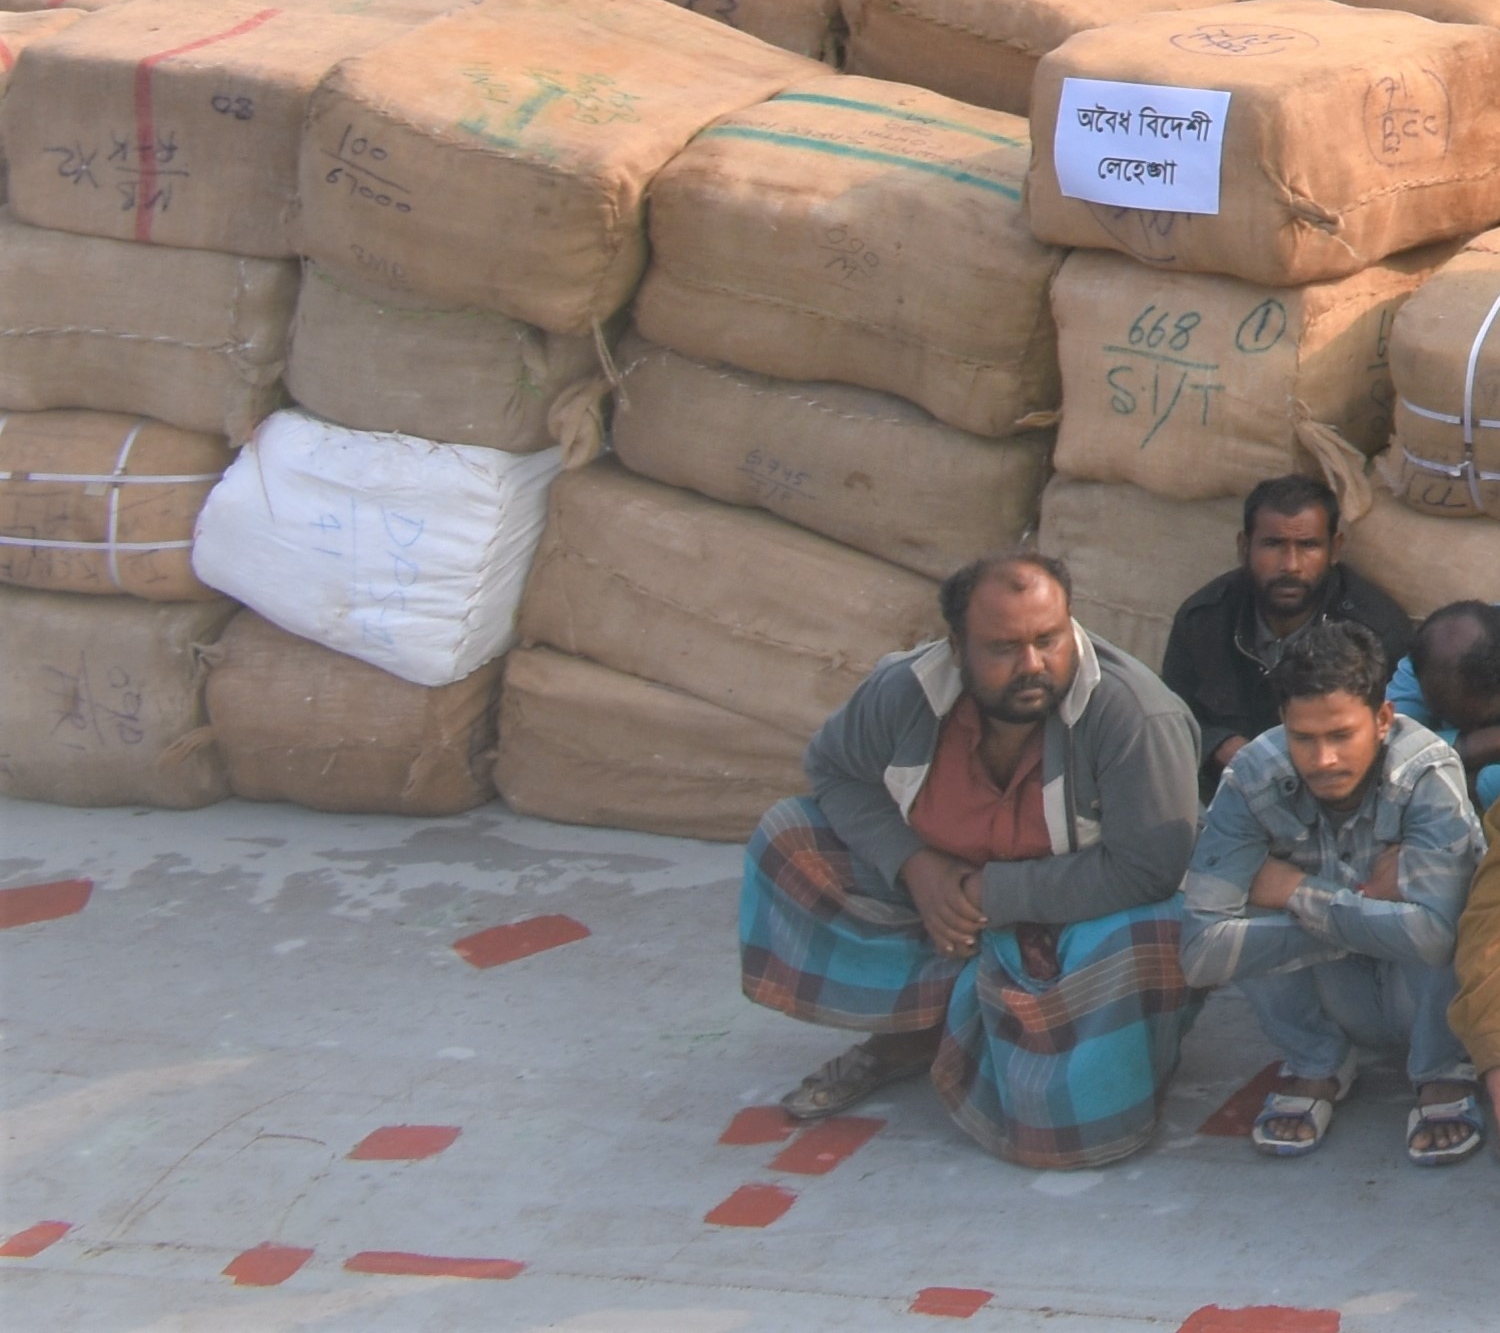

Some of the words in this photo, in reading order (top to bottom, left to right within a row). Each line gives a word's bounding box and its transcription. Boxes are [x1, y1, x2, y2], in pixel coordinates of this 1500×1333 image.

[1077, 105, 1129, 135] অবৈধ
[1139, 104, 1213, 142] বিদেশী
[1097, 156, 1177, 185] লেহেঙ্গা
[1127, 304, 1201, 351] 668
